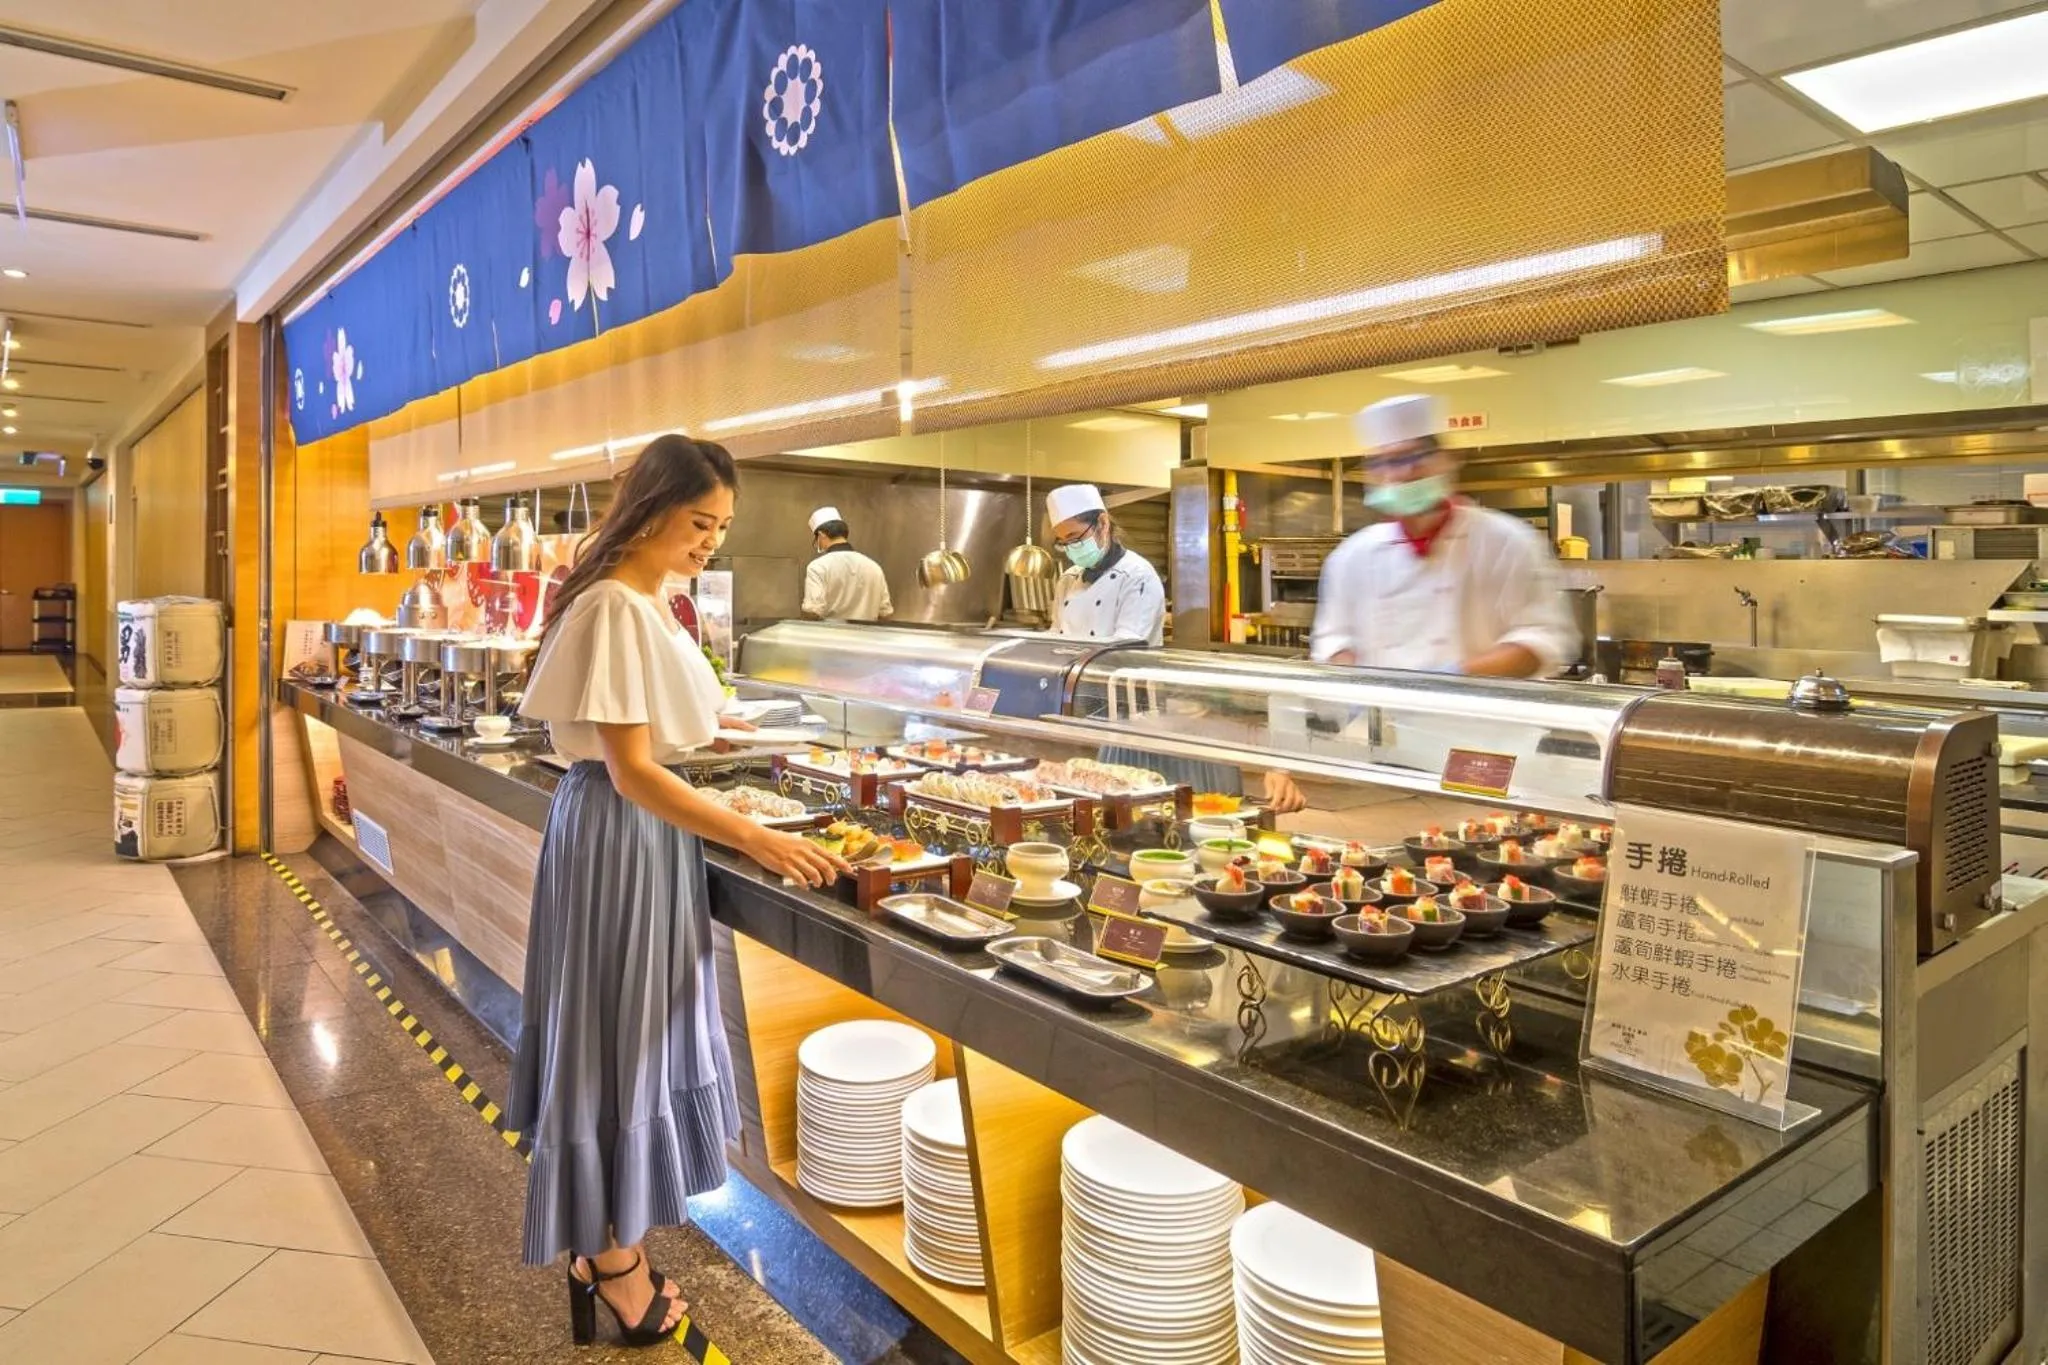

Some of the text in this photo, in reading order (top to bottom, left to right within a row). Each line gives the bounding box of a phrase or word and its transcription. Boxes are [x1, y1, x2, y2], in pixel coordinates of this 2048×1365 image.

[1625, 841, 1771, 890] 手捲 Hand-Rolled
[1620, 883, 1699, 916] 鮮蝦手捲
[1615, 908, 1698, 943] 蘆筍手捲
[1613, 934, 1738, 980] 蘆筍鮮蝦手捲
[1611, 962, 1692, 998] 水果手捲
